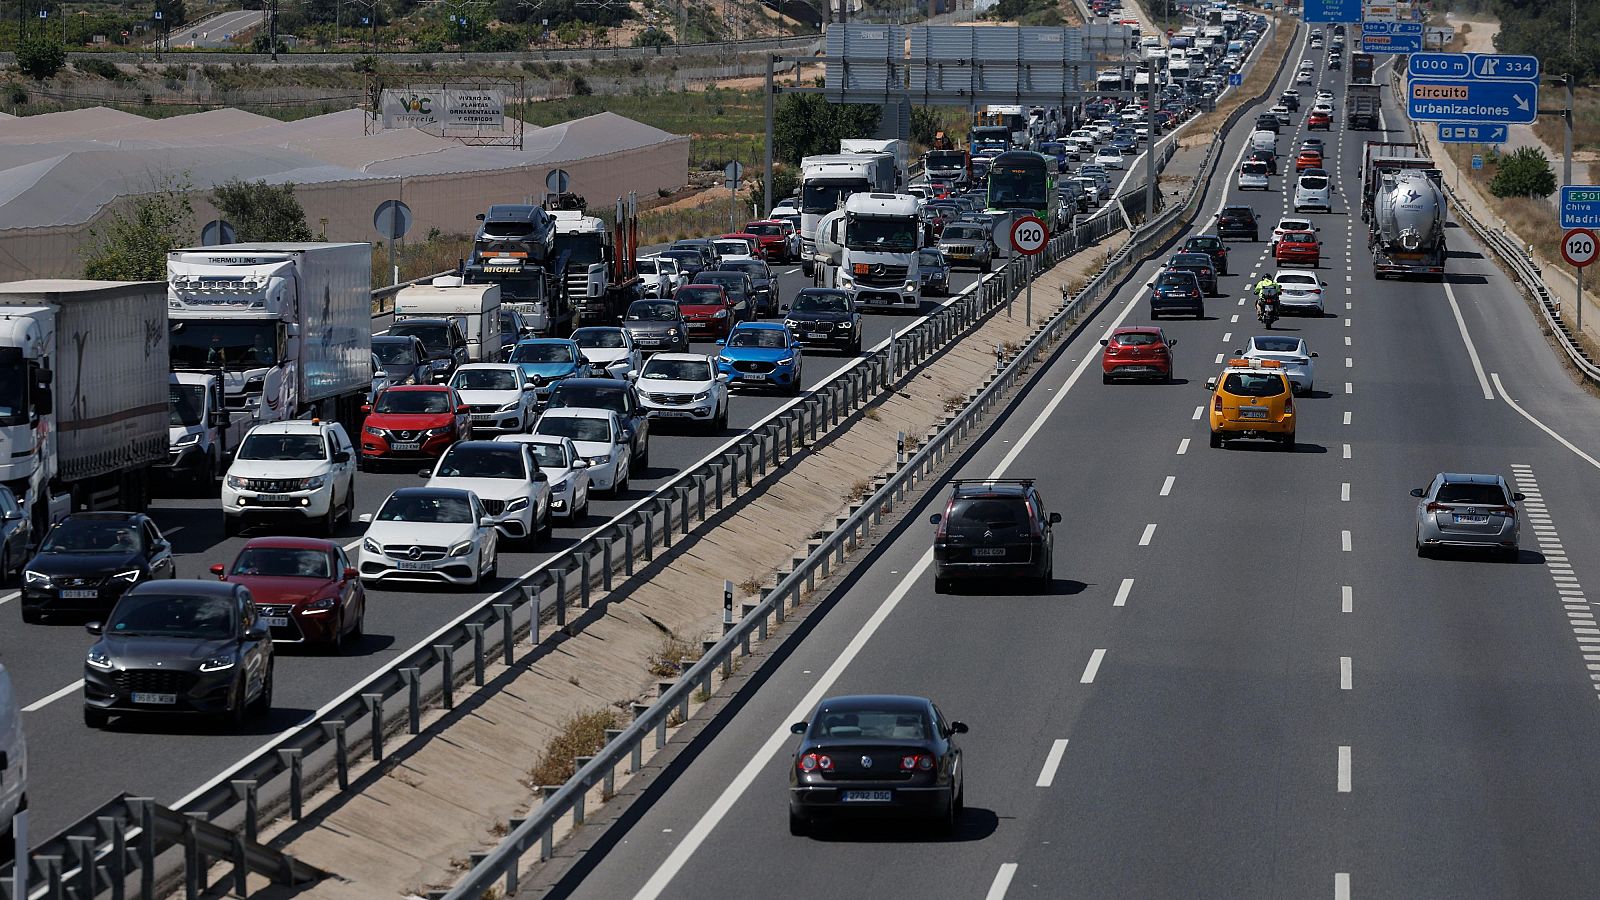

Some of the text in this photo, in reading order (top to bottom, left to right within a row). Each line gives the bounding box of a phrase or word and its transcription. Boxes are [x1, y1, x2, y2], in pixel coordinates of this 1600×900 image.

[1414, 60, 1464, 70] 1000 m
[1506, 62, 1532, 72] 334
[1414, 86, 1468, 98] circuito
[1414, 103, 1510, 116] urbanizaciones
[1566, 214, 1600, 224] Madri
[1018, 228, 1041, 242] 120
[1569, 241, 1592, 254] 120
[849, 792, 890, 800] 2792 DSC
